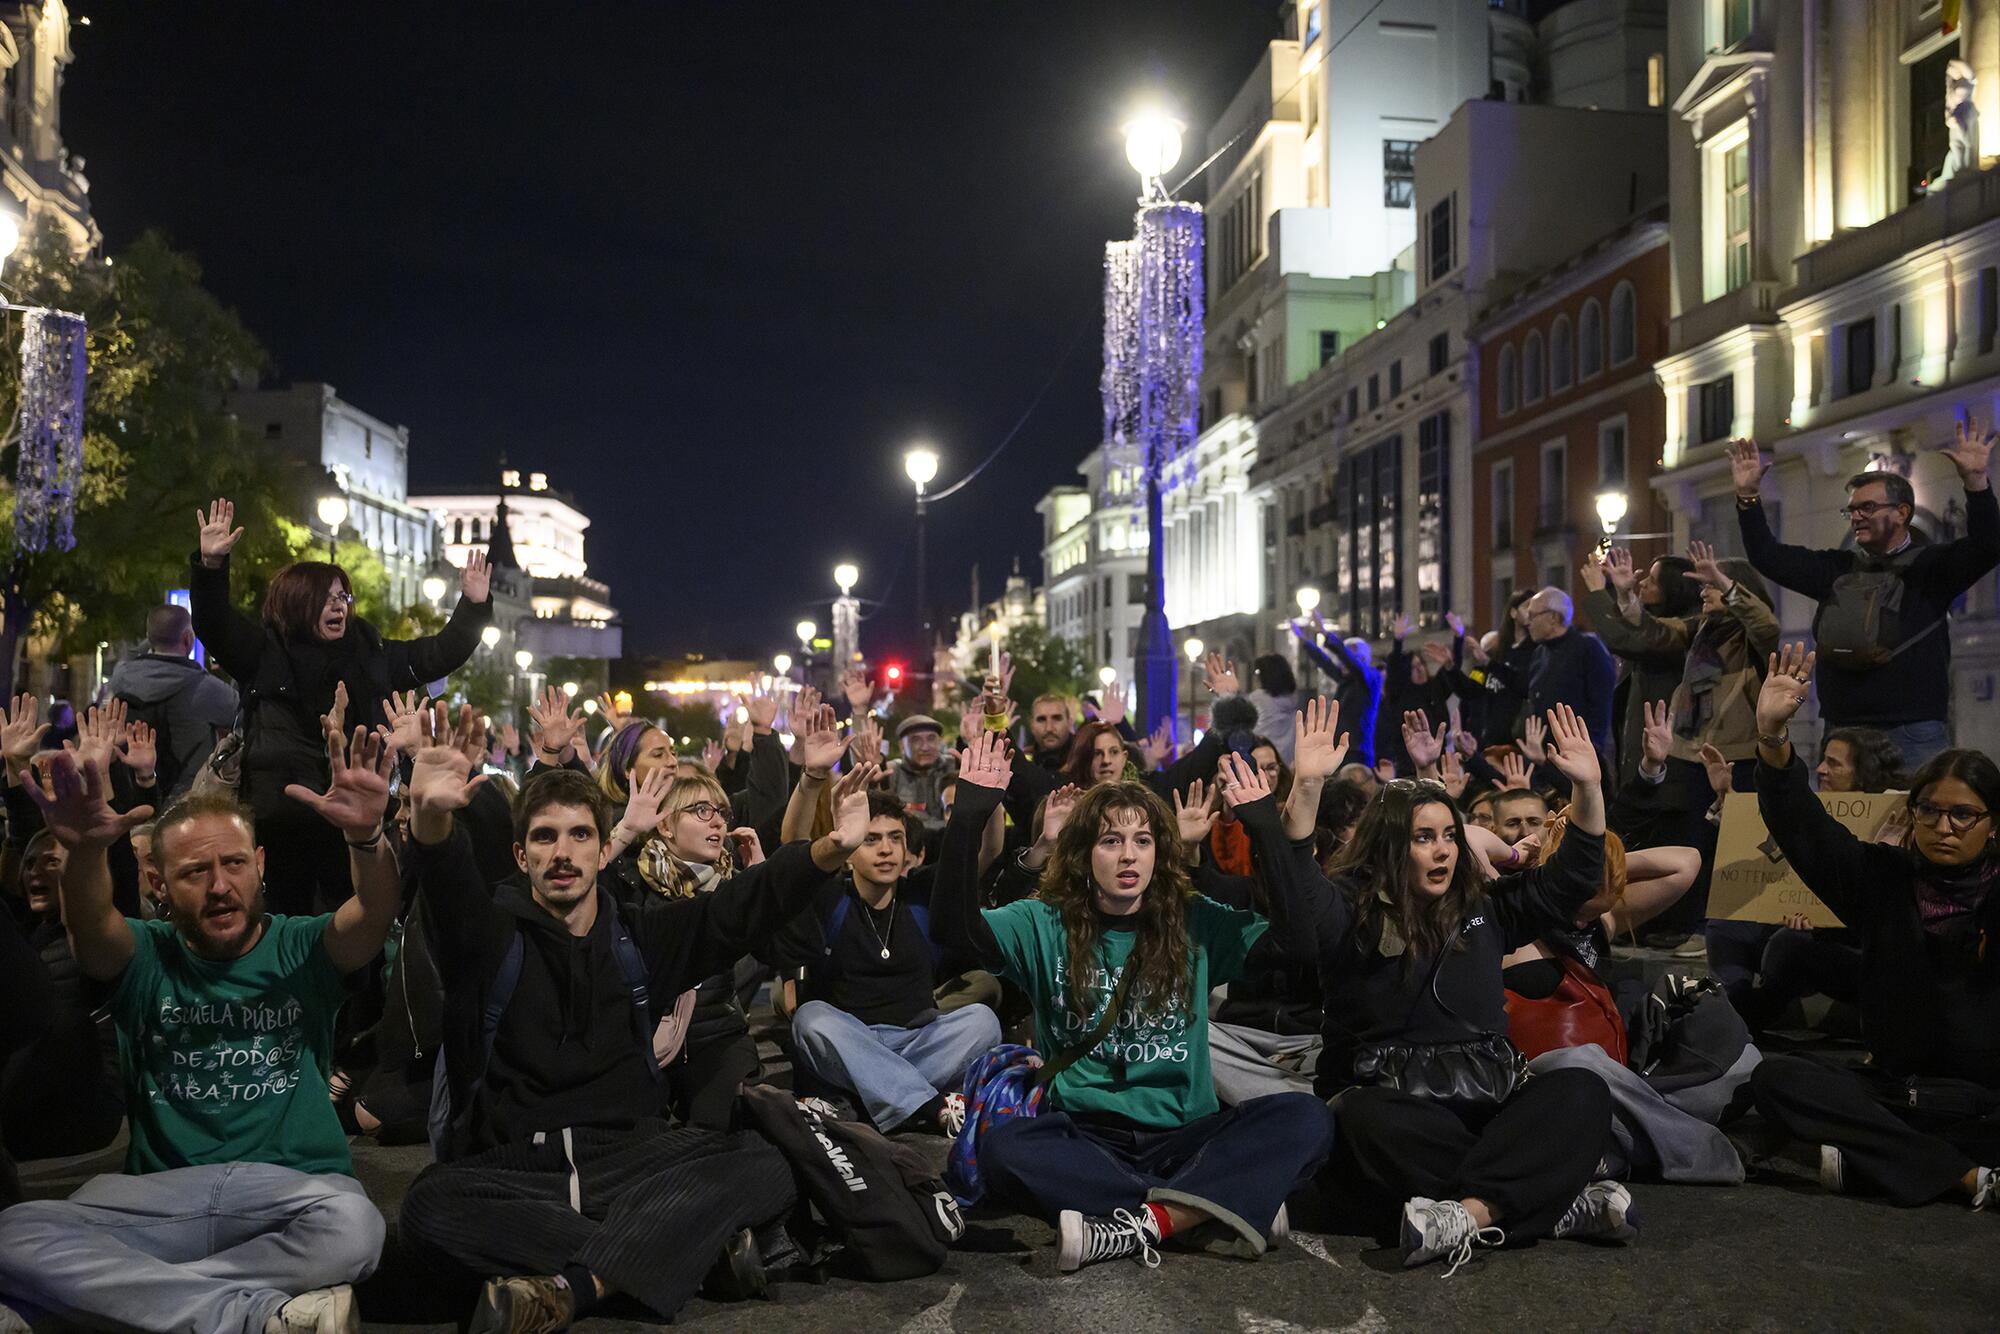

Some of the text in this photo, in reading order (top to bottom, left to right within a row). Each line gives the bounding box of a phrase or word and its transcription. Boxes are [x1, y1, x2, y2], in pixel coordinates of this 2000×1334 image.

[1825, 799, 1872, 819] ADO!
[1720, 868, 1739, 882] NO
[172, 1050, 203, 1067] DE
[171, 1082, 222, 1102] ARA
